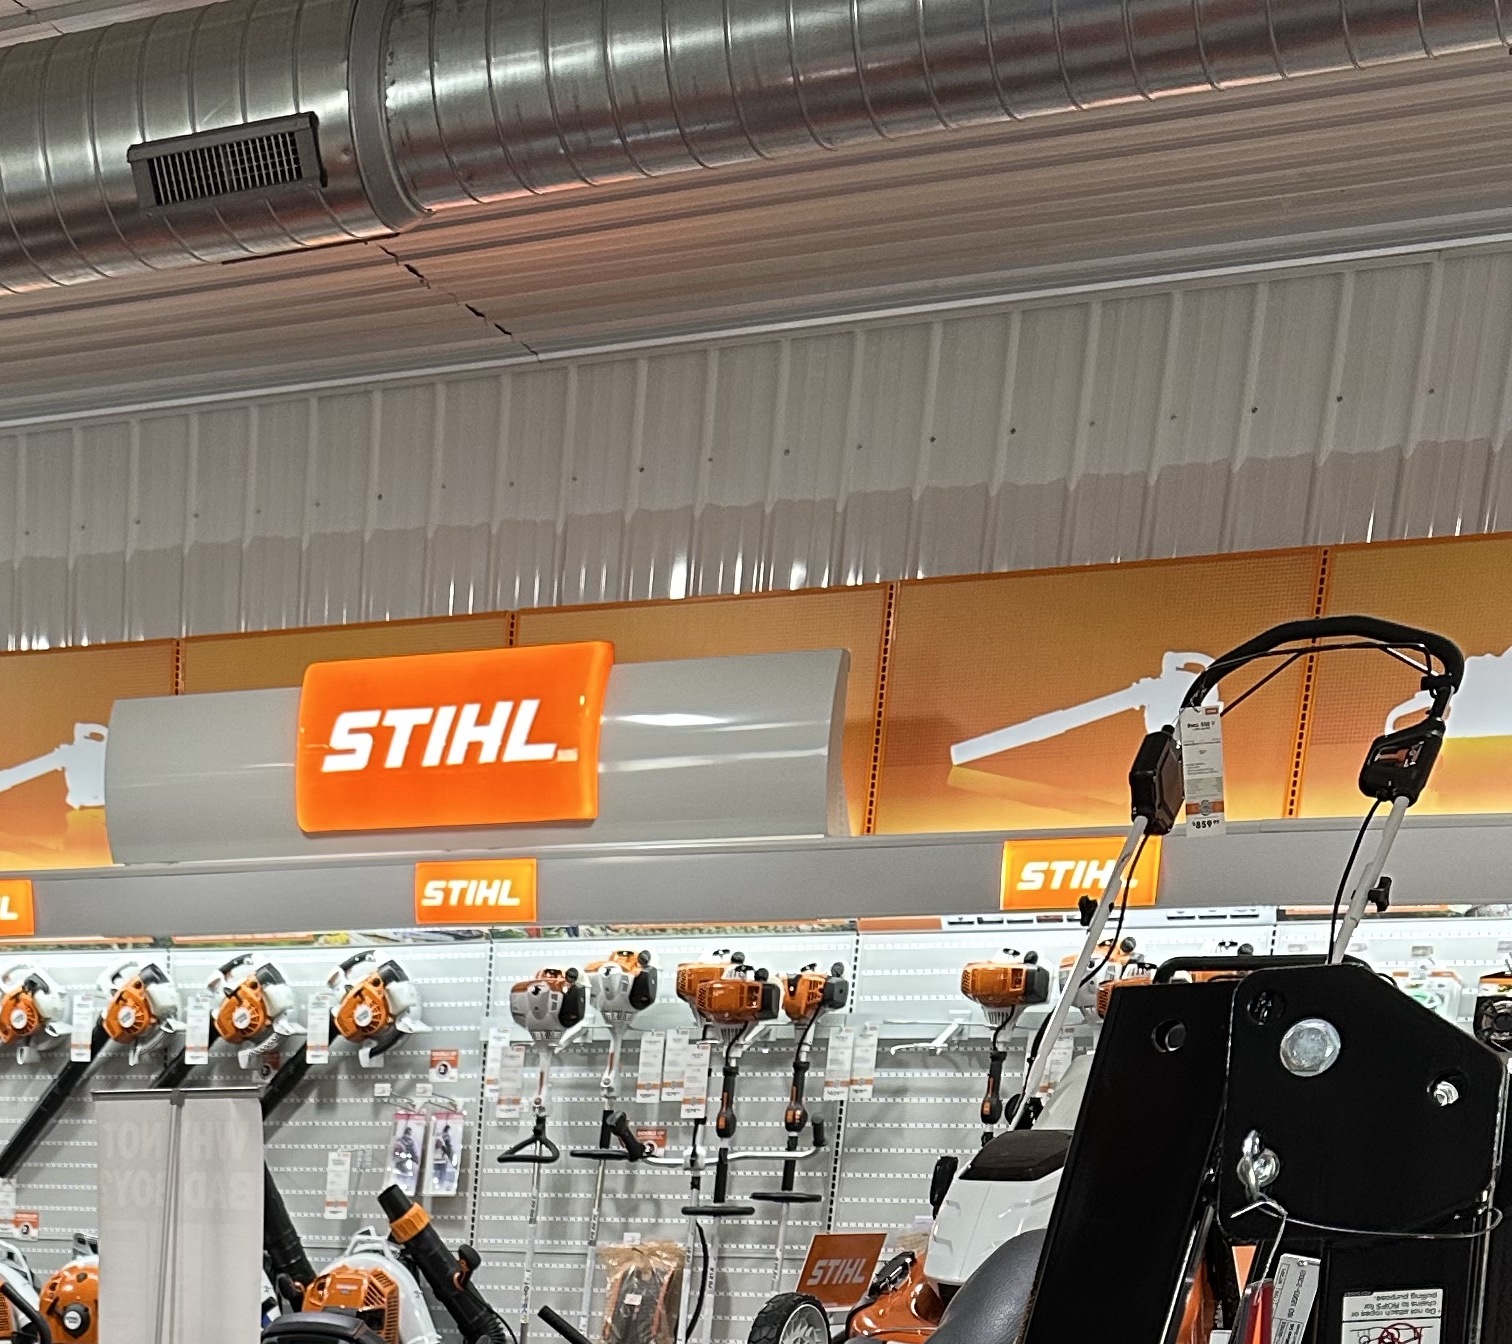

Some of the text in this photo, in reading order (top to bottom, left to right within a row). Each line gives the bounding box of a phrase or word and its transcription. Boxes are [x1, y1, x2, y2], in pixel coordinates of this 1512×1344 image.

[321, 699, 557, 773] STIHL
[416, 879, 521, 907] STIHL
[806, 1258, 866, 1286] STIHL
